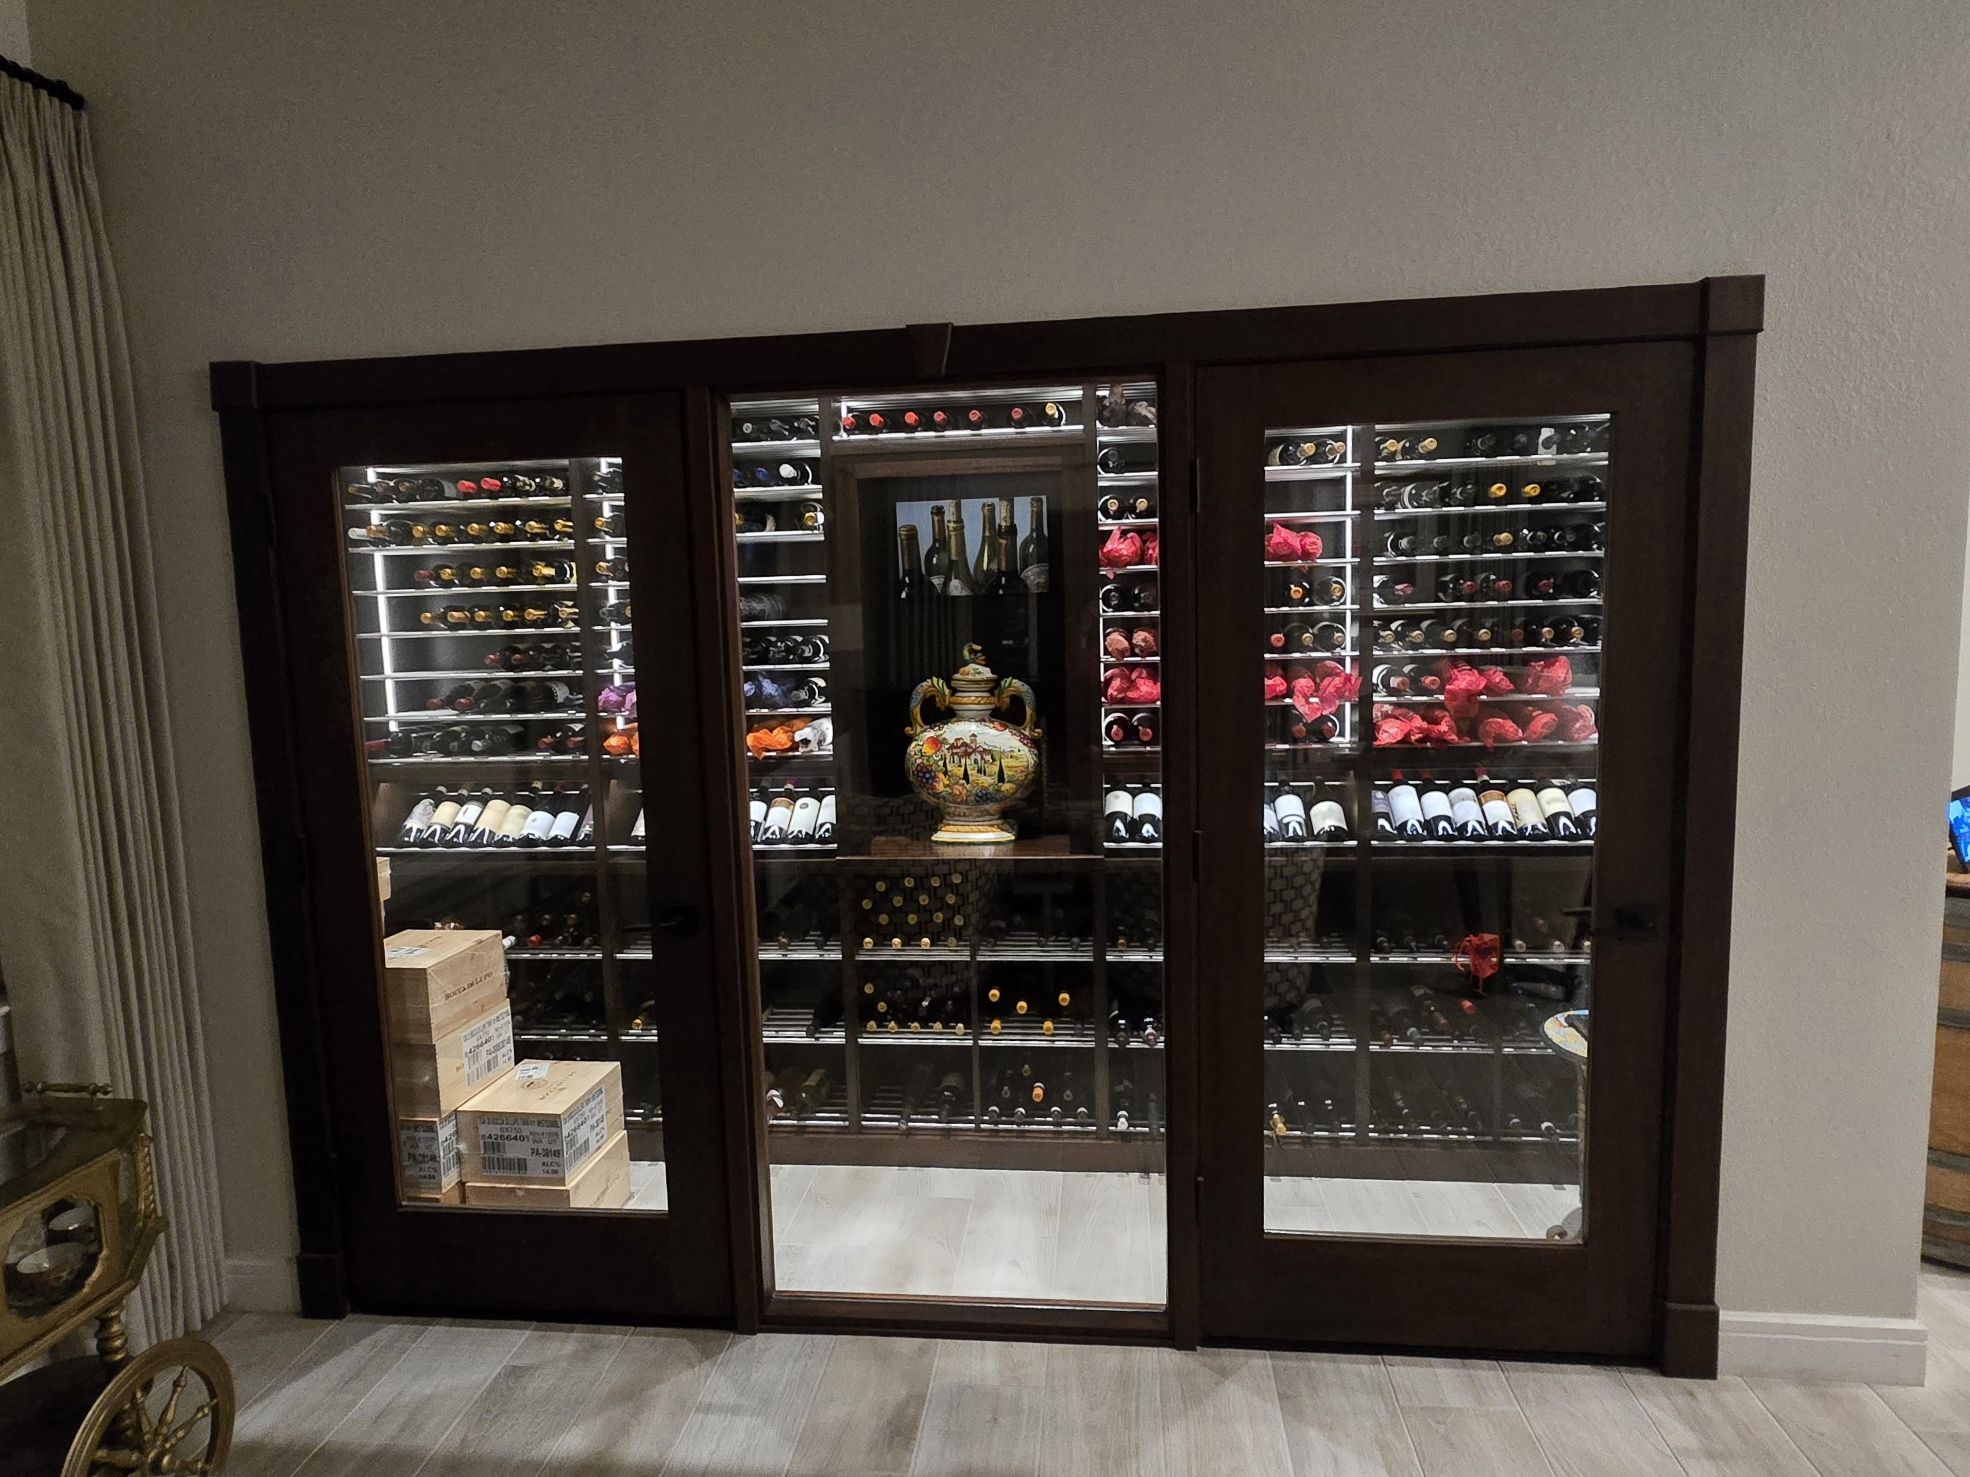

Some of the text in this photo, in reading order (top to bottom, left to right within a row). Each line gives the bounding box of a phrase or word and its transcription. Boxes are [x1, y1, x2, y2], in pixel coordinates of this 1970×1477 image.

[444, 971, 493, 1001] BOCCA DI LUPO
